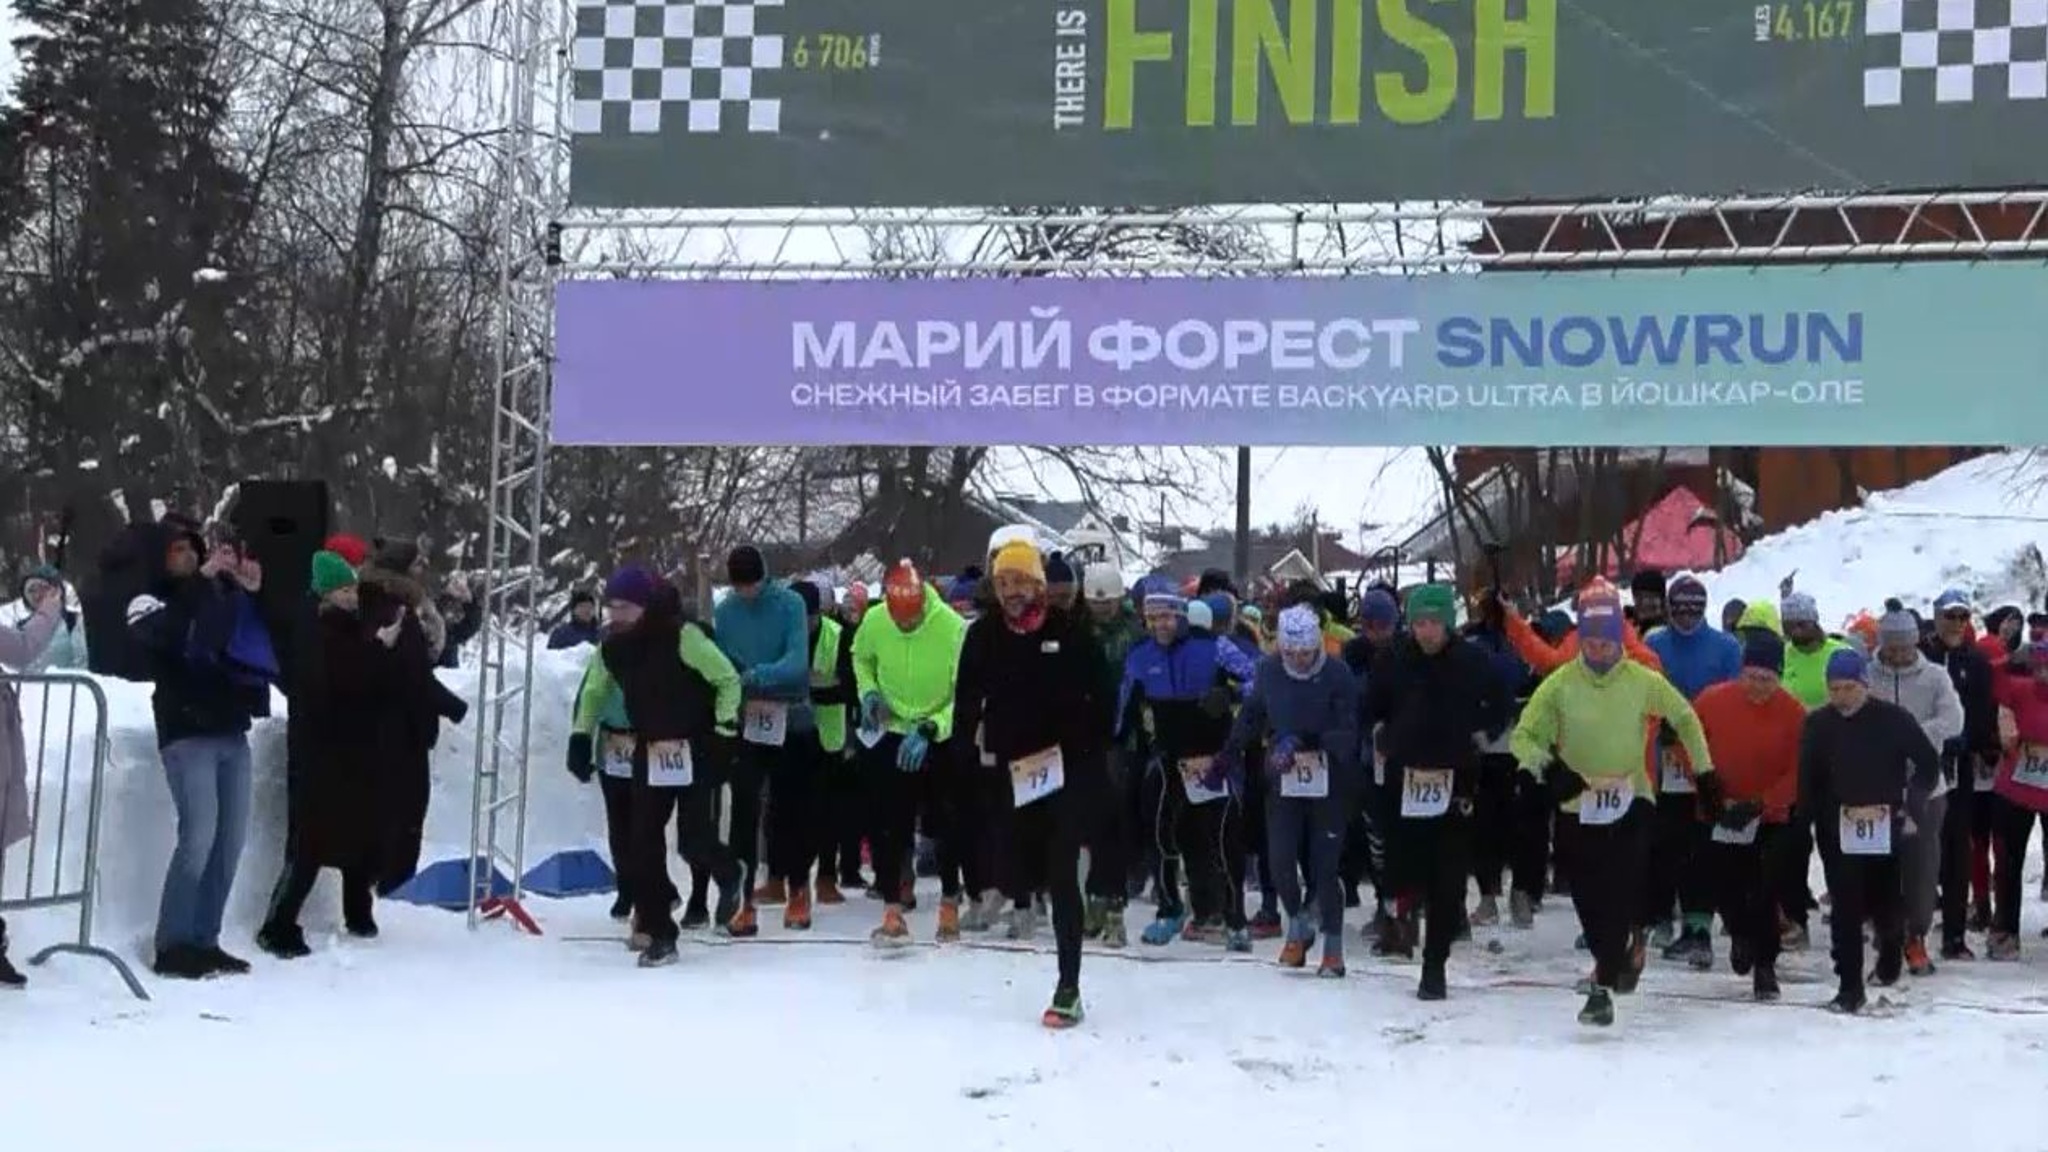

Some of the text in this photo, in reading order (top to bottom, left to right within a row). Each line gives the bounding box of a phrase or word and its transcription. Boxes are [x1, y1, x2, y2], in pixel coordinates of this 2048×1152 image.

[1775, 0, 1853, 40] 4.167
[819, 33, 867, 69] 706
[1104, 0, 1556, 128] FINISH
[1054, 10, 1087, 130] THERE IS
[791, 306, 1863, 370] МАРИЙ ФОРЕСТ SNOWRUN
[791, 377, 1863, 409] СНЕЖНЫЙ ЗАБЕГ В ФОРМАТЕ BACKYARD ULTRA В ЙОШКАР-ОЛЕ
[1027, 766, 1049, 790] 79
[1596, 788, 1621, 809] 116
[1856, 819, 1874, 840] 81
